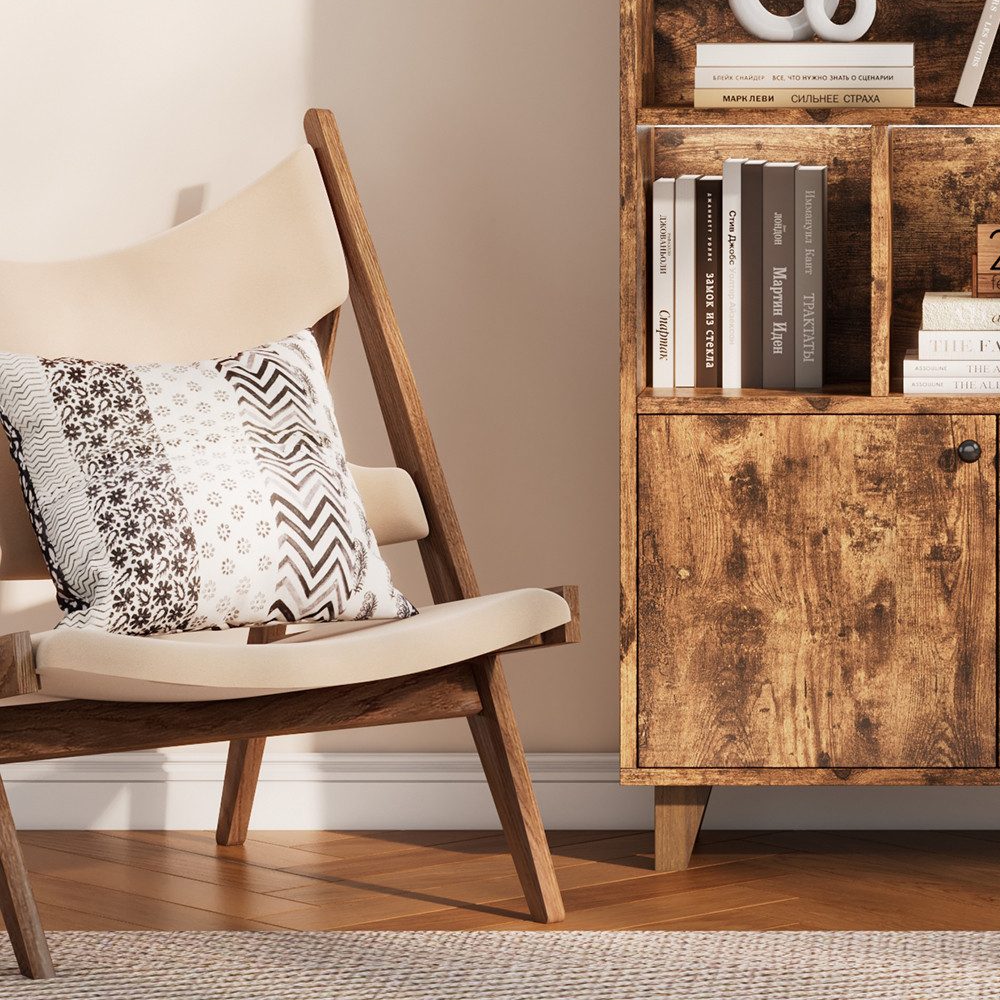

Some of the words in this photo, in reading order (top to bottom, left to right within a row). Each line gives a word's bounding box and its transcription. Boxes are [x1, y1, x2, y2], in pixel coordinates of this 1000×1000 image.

[981, 22, 992, 38] LES
[972, 40, 986, 68] JOURS
[790, 94, 838, 103] СИЛЬНЕЕ
[843, 94, 880, 103] СТРАХА
[728, 210, 736, 232] Стив
[804, 190, 816, 244] Иммануил
[728, 234, 736, 265] Джобс
[805, 249, 815, 275] Кант
[770, 266, 787, 316] Мартин
[656, 309, 670, 361] Спартак
[772, 322, 787, 355] Иден
[803, 293, 815, 363] ТРАКТАТЫ
[931, 340, 972, 352] THE
[968, 365, 988, 373] THE
[954, 381, 975, 390] THE
